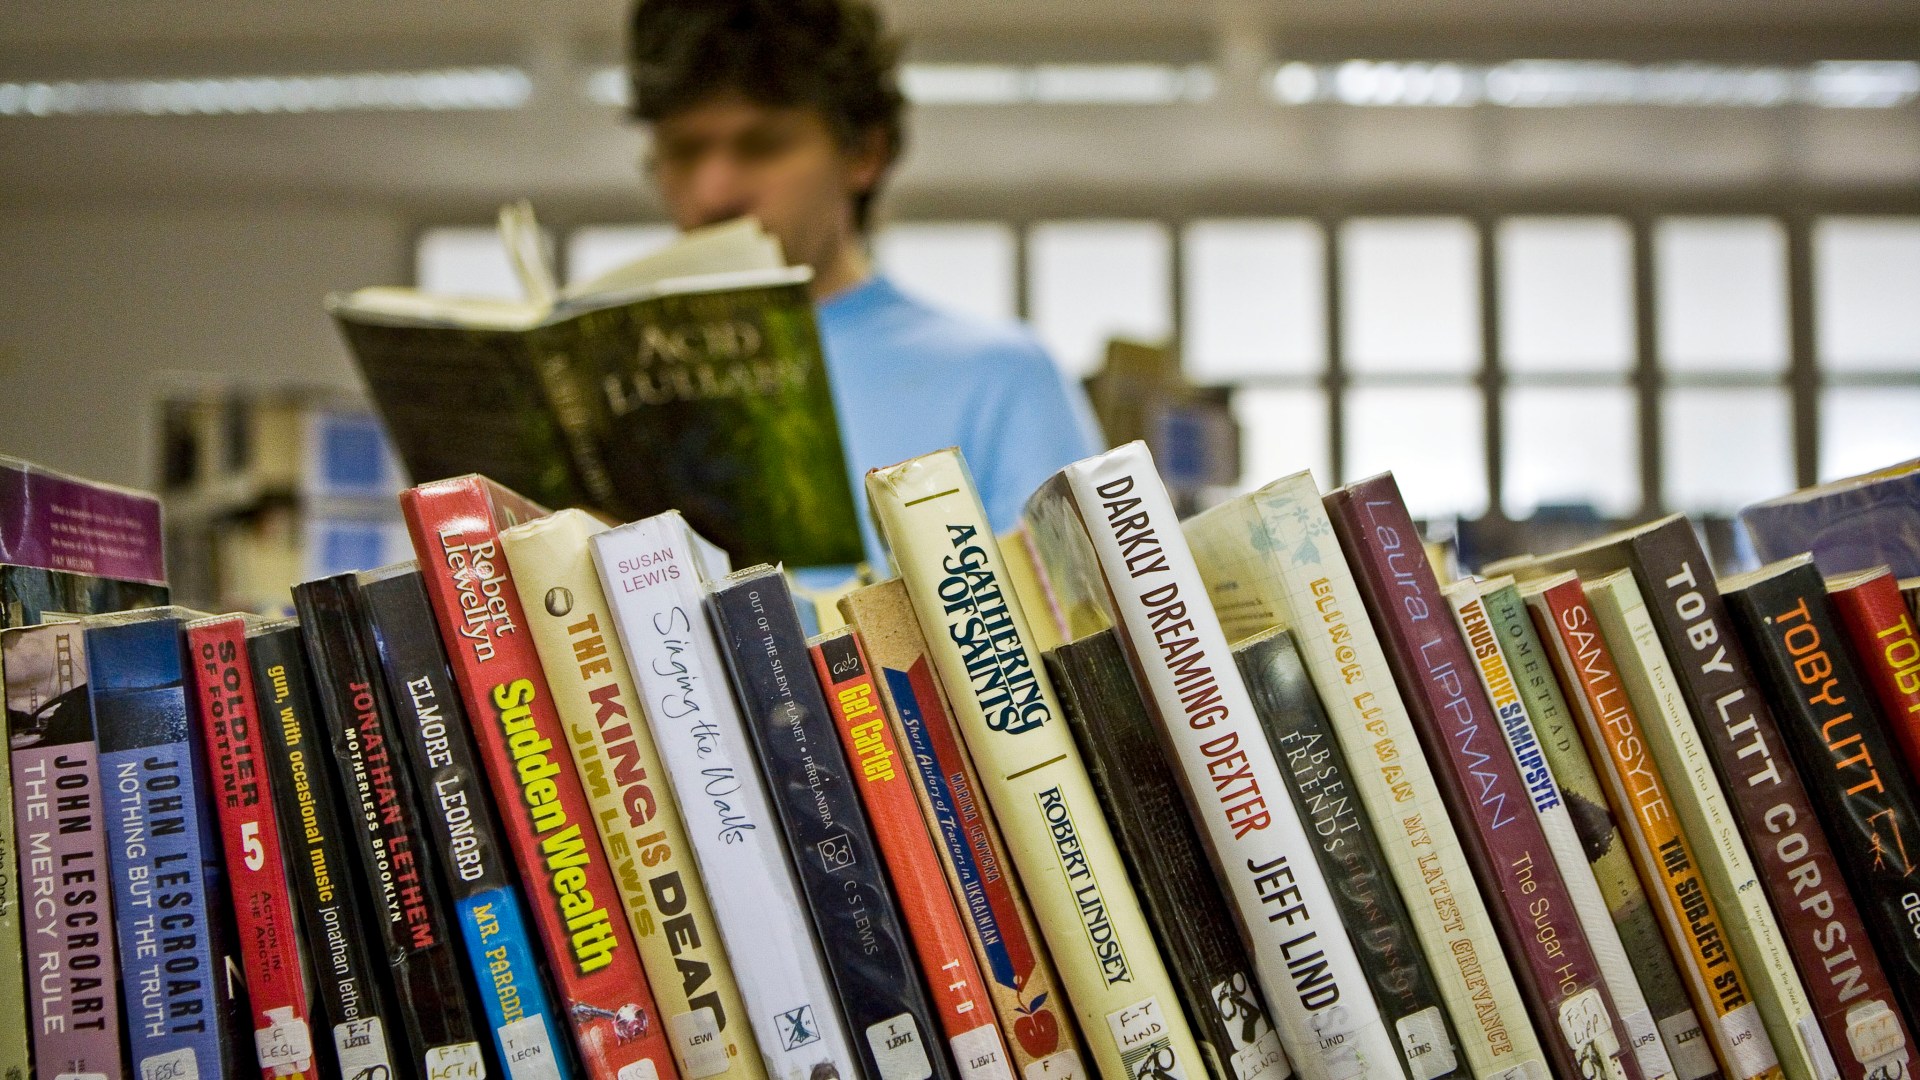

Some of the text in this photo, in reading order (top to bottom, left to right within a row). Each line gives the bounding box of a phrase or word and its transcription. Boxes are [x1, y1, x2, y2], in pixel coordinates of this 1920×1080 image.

[439, 530, 496, 663] Llewellyn
[470, 538, 517, 638] Robert
[618, 547, 675, 574] SUSAN
[622, 564, 681, 593] LEWIS
[567, 613, 613, 680] THE
[652, 606, 700, 719] Singing
[690, 720, 721, 759] the
[749, 591, 806, 743] OUT OF THE SILENT PLANET
[937, 576, 1020, 732] OF SAINTS
[942, 524, 1052, 735] A GATHERING
[1096, 475, 1170, 579] DARKLY
[1140, 582, 1229, 730] DREAMING
[1200, 731, 1271, 841] DEXTER
[1366, 500, 1515, 830] Laura LIPPMAN
[1502, 606, 1571, 753] HOMESTEAD
[1776, 597, 1846, 706] TOBY
[1876, 614, 1920, 713] TOB
[202, 643, 239, 809] OF FORTUNE
[218, 639, 260, 808] SOLDIER
[838, 683, 895, 782] Get Carter
[905, 716, 925, 751] Short
[1310, 576, 1416, 804] ELINOR LIPMAN
[1562, 604, 1611, 685] SAM
[1596, 687, 1669, 827] LIPSYTE
[54, 755, 92, 835] JOHN
[267, 665, 335, 902] gun, with occasional music
[407, 676, 484, 882] ELMORE LEONARD
[589, 683, 656, 829] KING
[803, 755, 834, 829] PERELANDRA
[936, 800, 949, 812] of
[1280, 731, 1344, 852] FRIENDS
[1302, 732, 1361, 833] ABSENT
[1652, 663, 1667, 690] Too
[1663, 691, 1683, 728] Soon
[1694, 765, 1709, 793] Too
[1706, 795, 1722, 825] Late
[1720, 826, 1742, 870] Smart
[1666, 562, 1869, 1003] TOBY LITT CORPSIN
[240, 821, 265, 872] 5
[344, 728, 402, 922] MOTHERLESS BROOKLYN
[350, 682, 434, 949] JONATHAN LETHEM
[494, 678, 618, 974] Sudden Wealth
[571, 723, 655, 938] JIM LEWIS
[636, 831, 671, 867] IS
[941, 815, 967, 872] Tractors
[949, 772, 1001, 883] MARINA LEWYCKA
[24, 759, 65, 1036] THE MERCY RULE
[116, 761, 166, 1038] NOTHING BUT THE TRUTH
[143, 757, 205, 1034] JOHN LESCROART
[844, 880, 878, 956] C S LEWIS
[961, 868, 970, 880] in
[965, 881, 999, 946] UKRAINIAN
[1039, 786, 1131, 986] ROBERT LINDSEY
[1247, 856, 1310, 926] JEFF
[1345, 852, 1380, 922] GILLIAN
[1511, 851, 1578, 996] The Sugar Ho
[1658, 835, 1747, 1011] THE SUBJECT STE
[61, 851, 105, 1031] LESCROART
[250, 893, 271, 983] THE ARCTIC
[262, 891, 281, 971] ACTION IN
[319, 906, 349, 975] jonathan
[473, 902, 526, 1025] MR. PARADIS
[1404, 813, 1513, 1056] MY LATEST GRIEVANCE
[273, 1029, 285, 1041] F
[512, 1046, 541, 1063] LECN
[689, 1032, 713, 1046] LEWI
[886, 1032, 914, 1050] LEWI
[970, 1052, 997, 1069] LEWI
[1319, 1035, 1344, 1049] LIND
[1633, 1033, 1655, 1048] LIPS
[1731, 1030, 1752, 1047] LIPS
